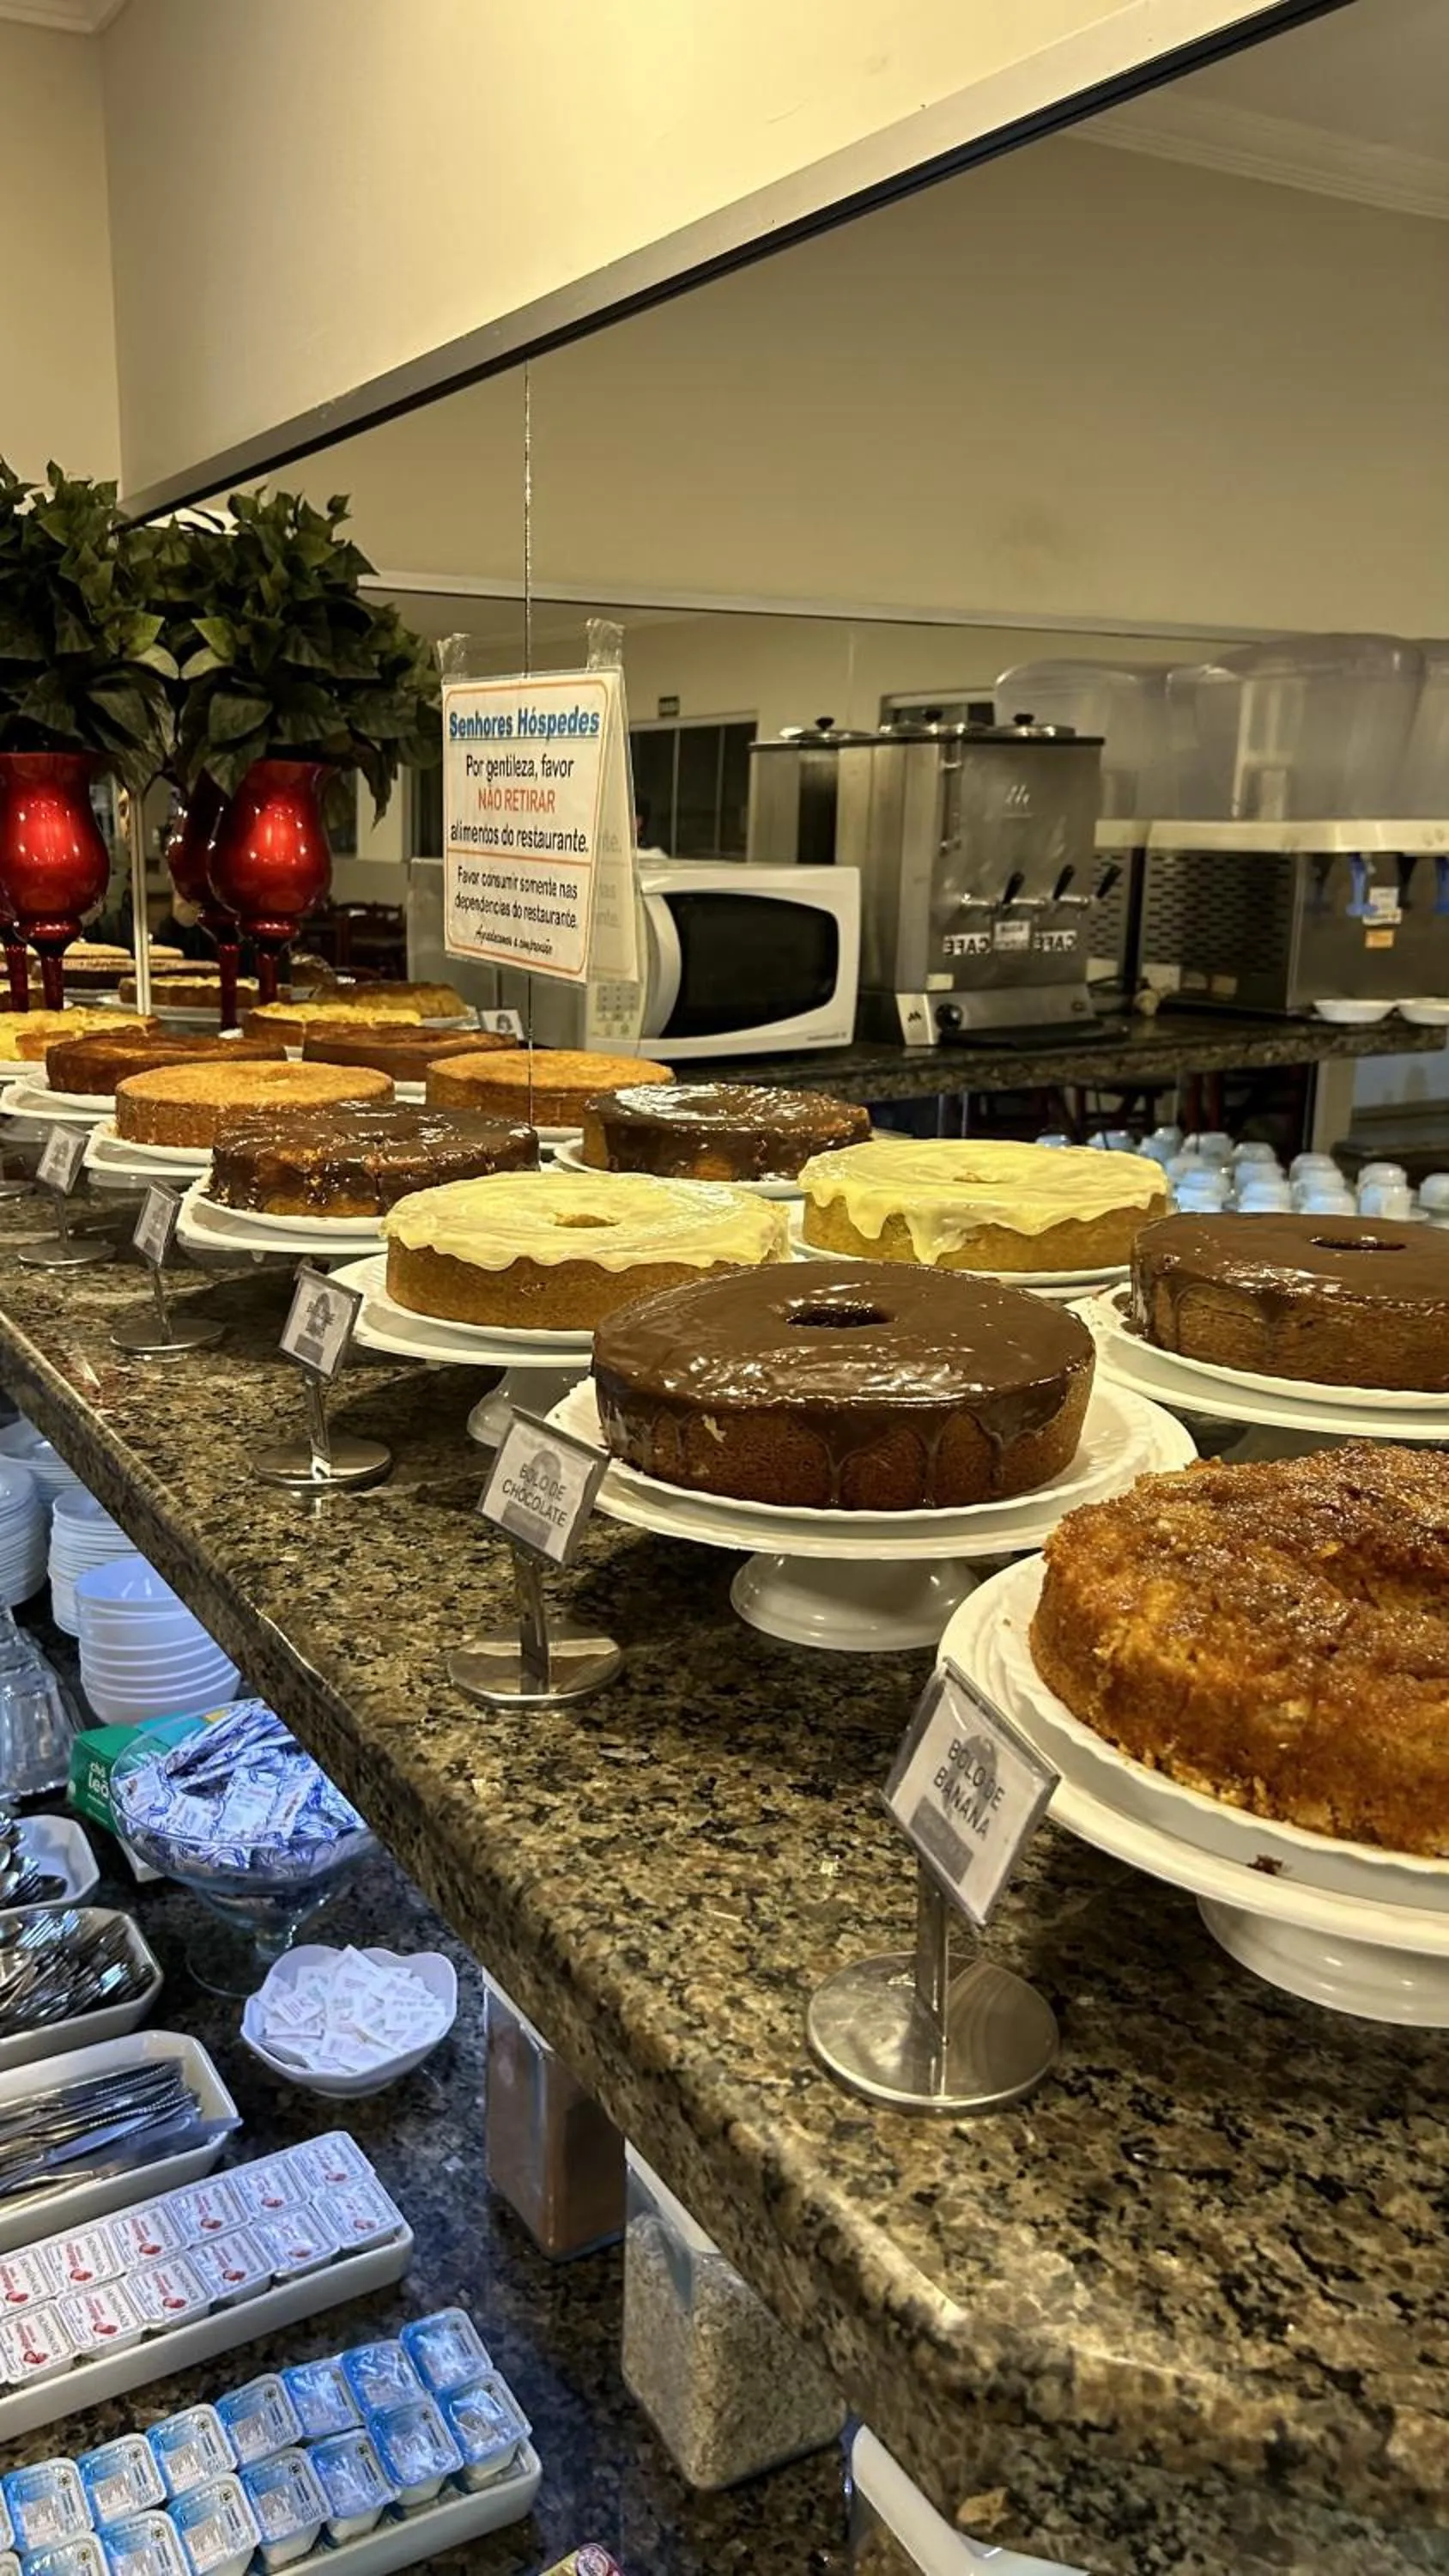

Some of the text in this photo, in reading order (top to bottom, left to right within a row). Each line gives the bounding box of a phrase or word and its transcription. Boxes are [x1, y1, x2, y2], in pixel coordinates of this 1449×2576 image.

[449, 705, 600, 744] Senhores Hóspedes
[466, 752, 575, 782] Por gentileza, favor
[478, 783, 556, 814] NÃO RETIRAR
[451, 821, 500, 846] alimentos
[500, 823, 514, 847] do
[516, 826, 590, 854] restaurante.
[458, 865, 480, 885] Favor
[481, 871, 518, 890] consumir
[519, 876, 557, 897] somente
[559, 883, 578, 900] nas
[512, 899, 523, 920] do
[519, 1463, 567, 1502] BOLO DE
[502, 1479, 567, 1528] CHOCOLATE
[88, 1771, 110, 1799] leã
[947, 1738, 1006, 1812] BOLO DE
[933, 1765, 991, 1842] BANANA
